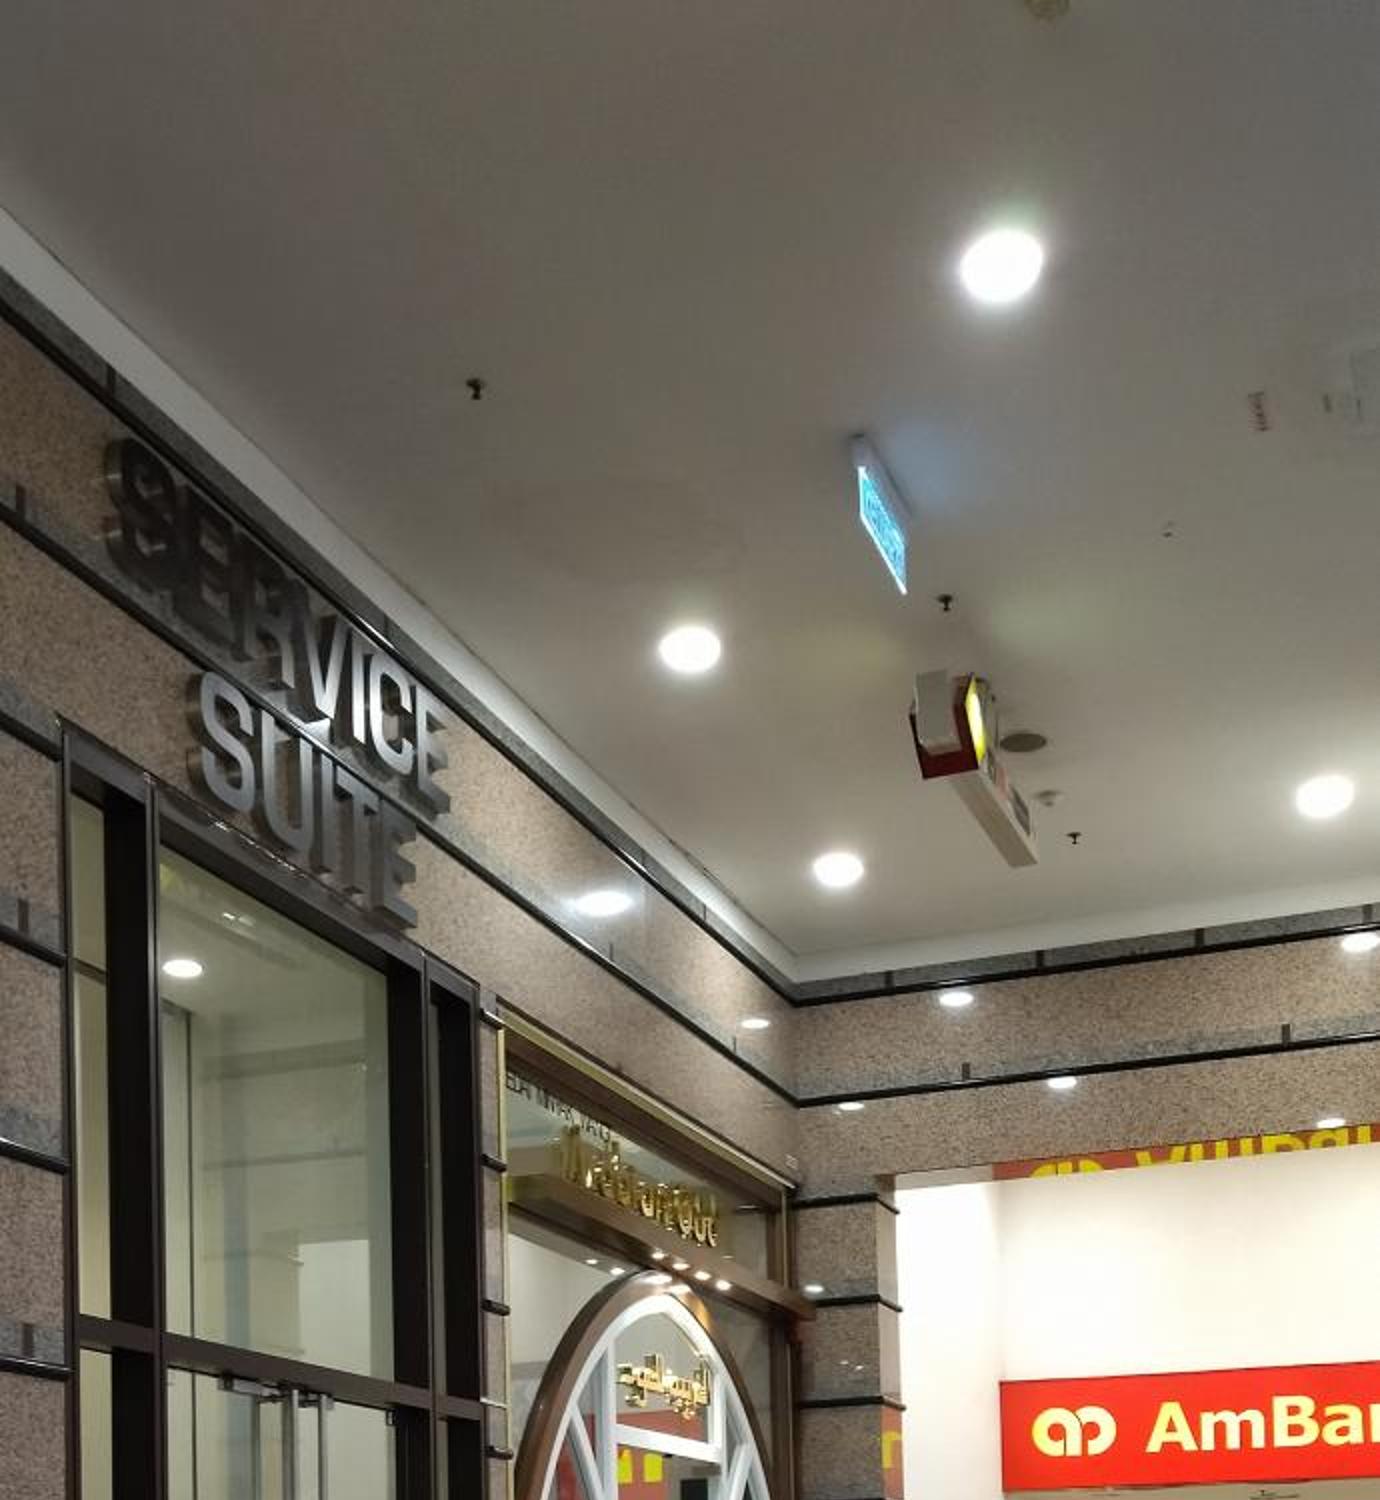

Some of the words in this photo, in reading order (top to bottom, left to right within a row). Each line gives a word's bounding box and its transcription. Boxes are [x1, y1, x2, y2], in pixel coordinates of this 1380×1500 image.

[105, 437, 450, 815] SERVICE
[188, 669, 417, 928] SUITE
[1145, 1394, 1380, 1453] AmBa
